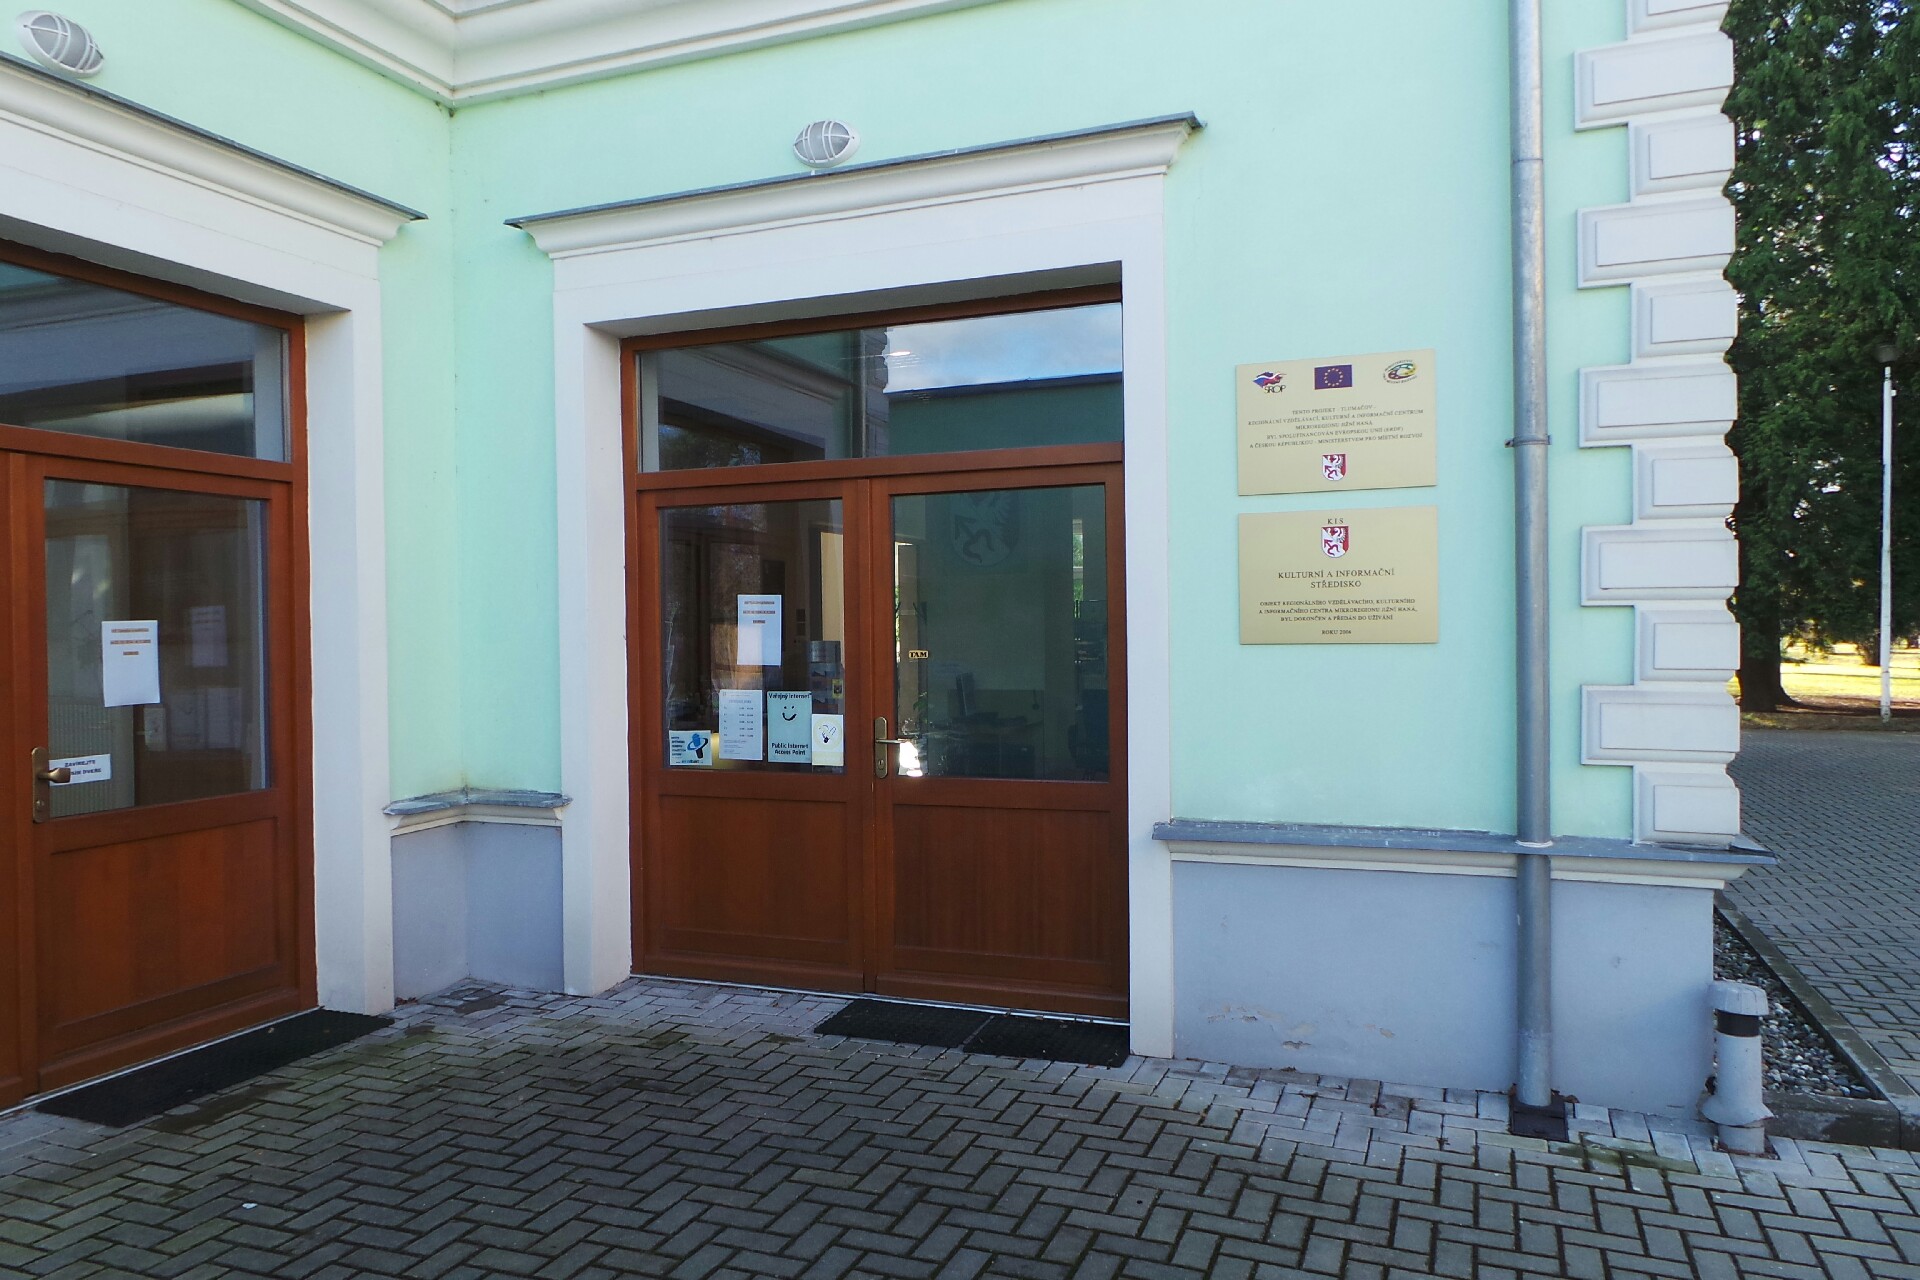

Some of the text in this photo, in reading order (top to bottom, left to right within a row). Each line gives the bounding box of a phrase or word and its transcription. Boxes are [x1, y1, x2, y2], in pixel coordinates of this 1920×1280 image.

[1278, 570, 1324, 578] KULTURNÍ
[1336, 568, 1395, 577] INFORMAČNÍ
[1310, 580, 1362, 588] STŘEDISKO
